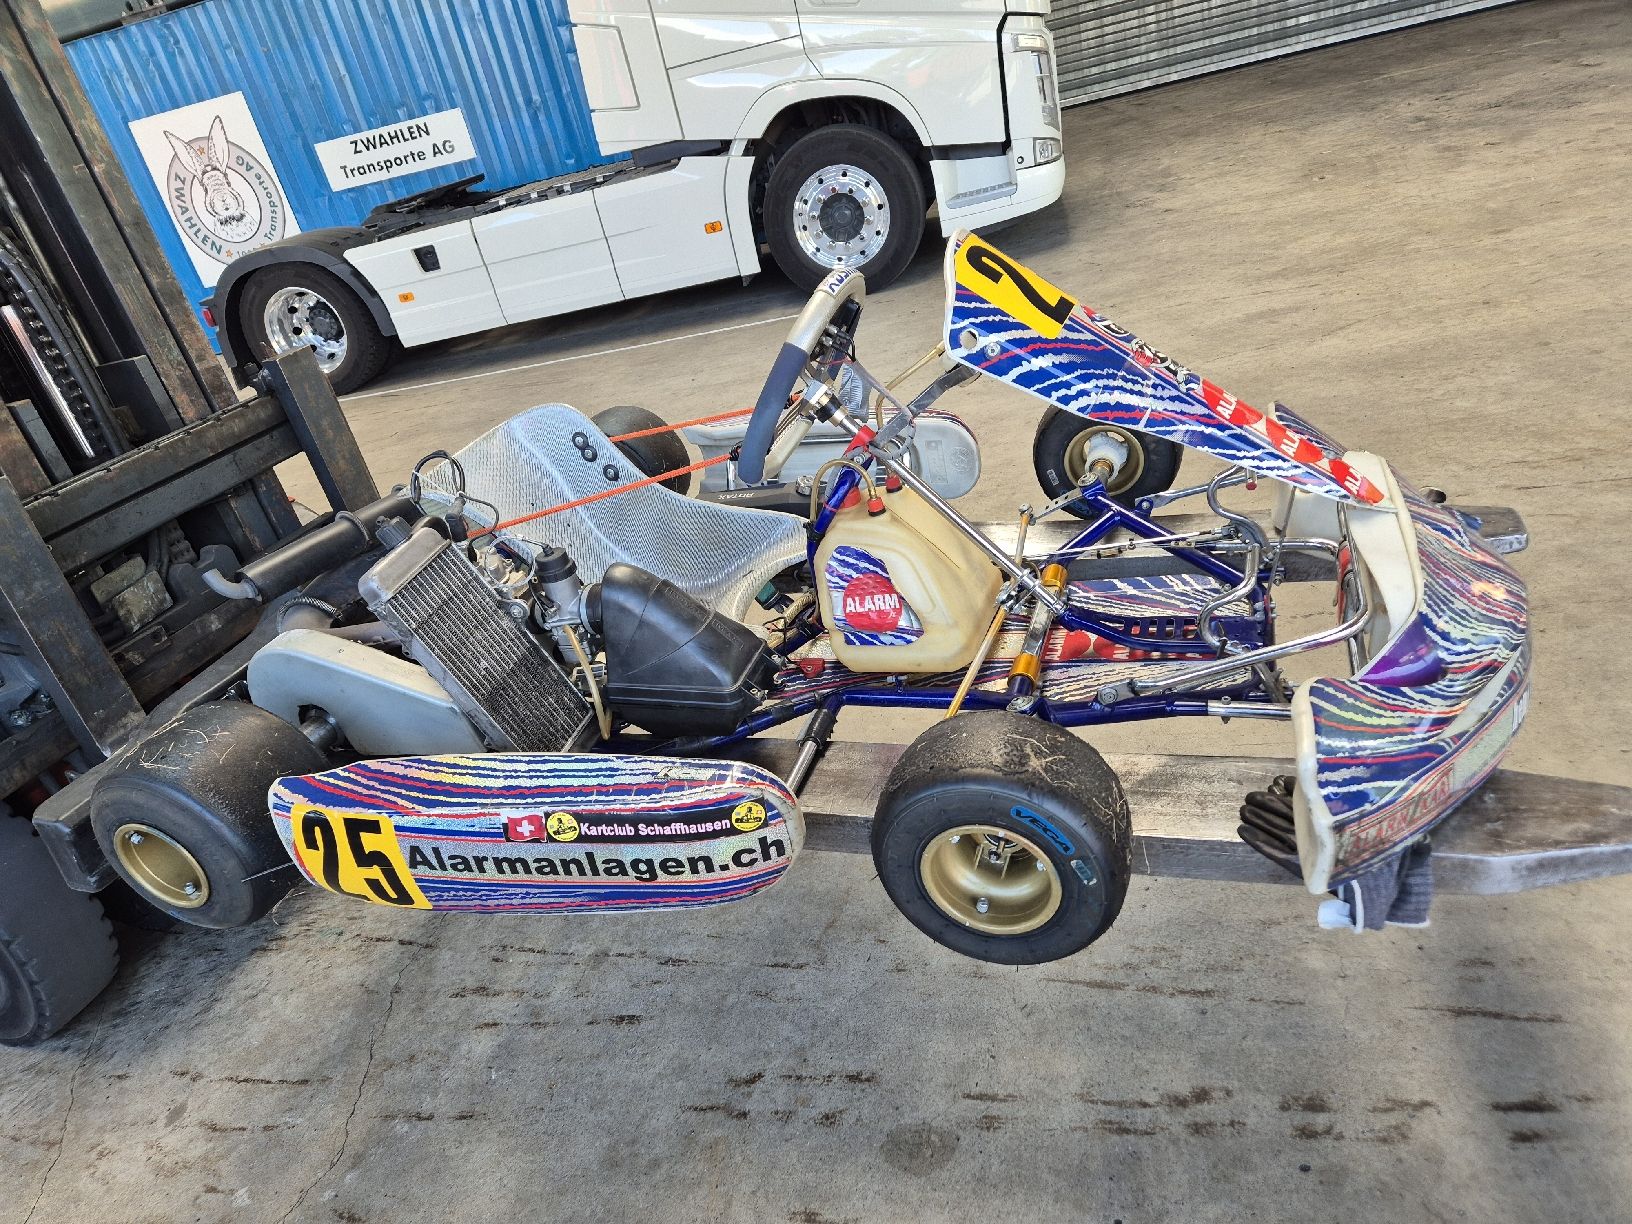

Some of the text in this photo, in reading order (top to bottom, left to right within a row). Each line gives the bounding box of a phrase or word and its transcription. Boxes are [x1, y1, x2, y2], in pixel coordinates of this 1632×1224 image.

[340, 139, 456, 179] Transporte AG
[350, 121, 431, 155] ZWAHLEN
[174, 171, 223, 256] ZWAHLEN
[235, 154, 279, 242] Transporte AG
[965, 245, 1076, 326] 2
[845, 593, 900, 614] ALARM
[580, 822, 635, 836] Kartclub
[638, 819, 731, 836] Schaffhausen
[1015, 808, 1071, 854] VEGA
[301, 809, 416, 906] 25
[408, 836, 787, 883] Alarmanlagen.ch
